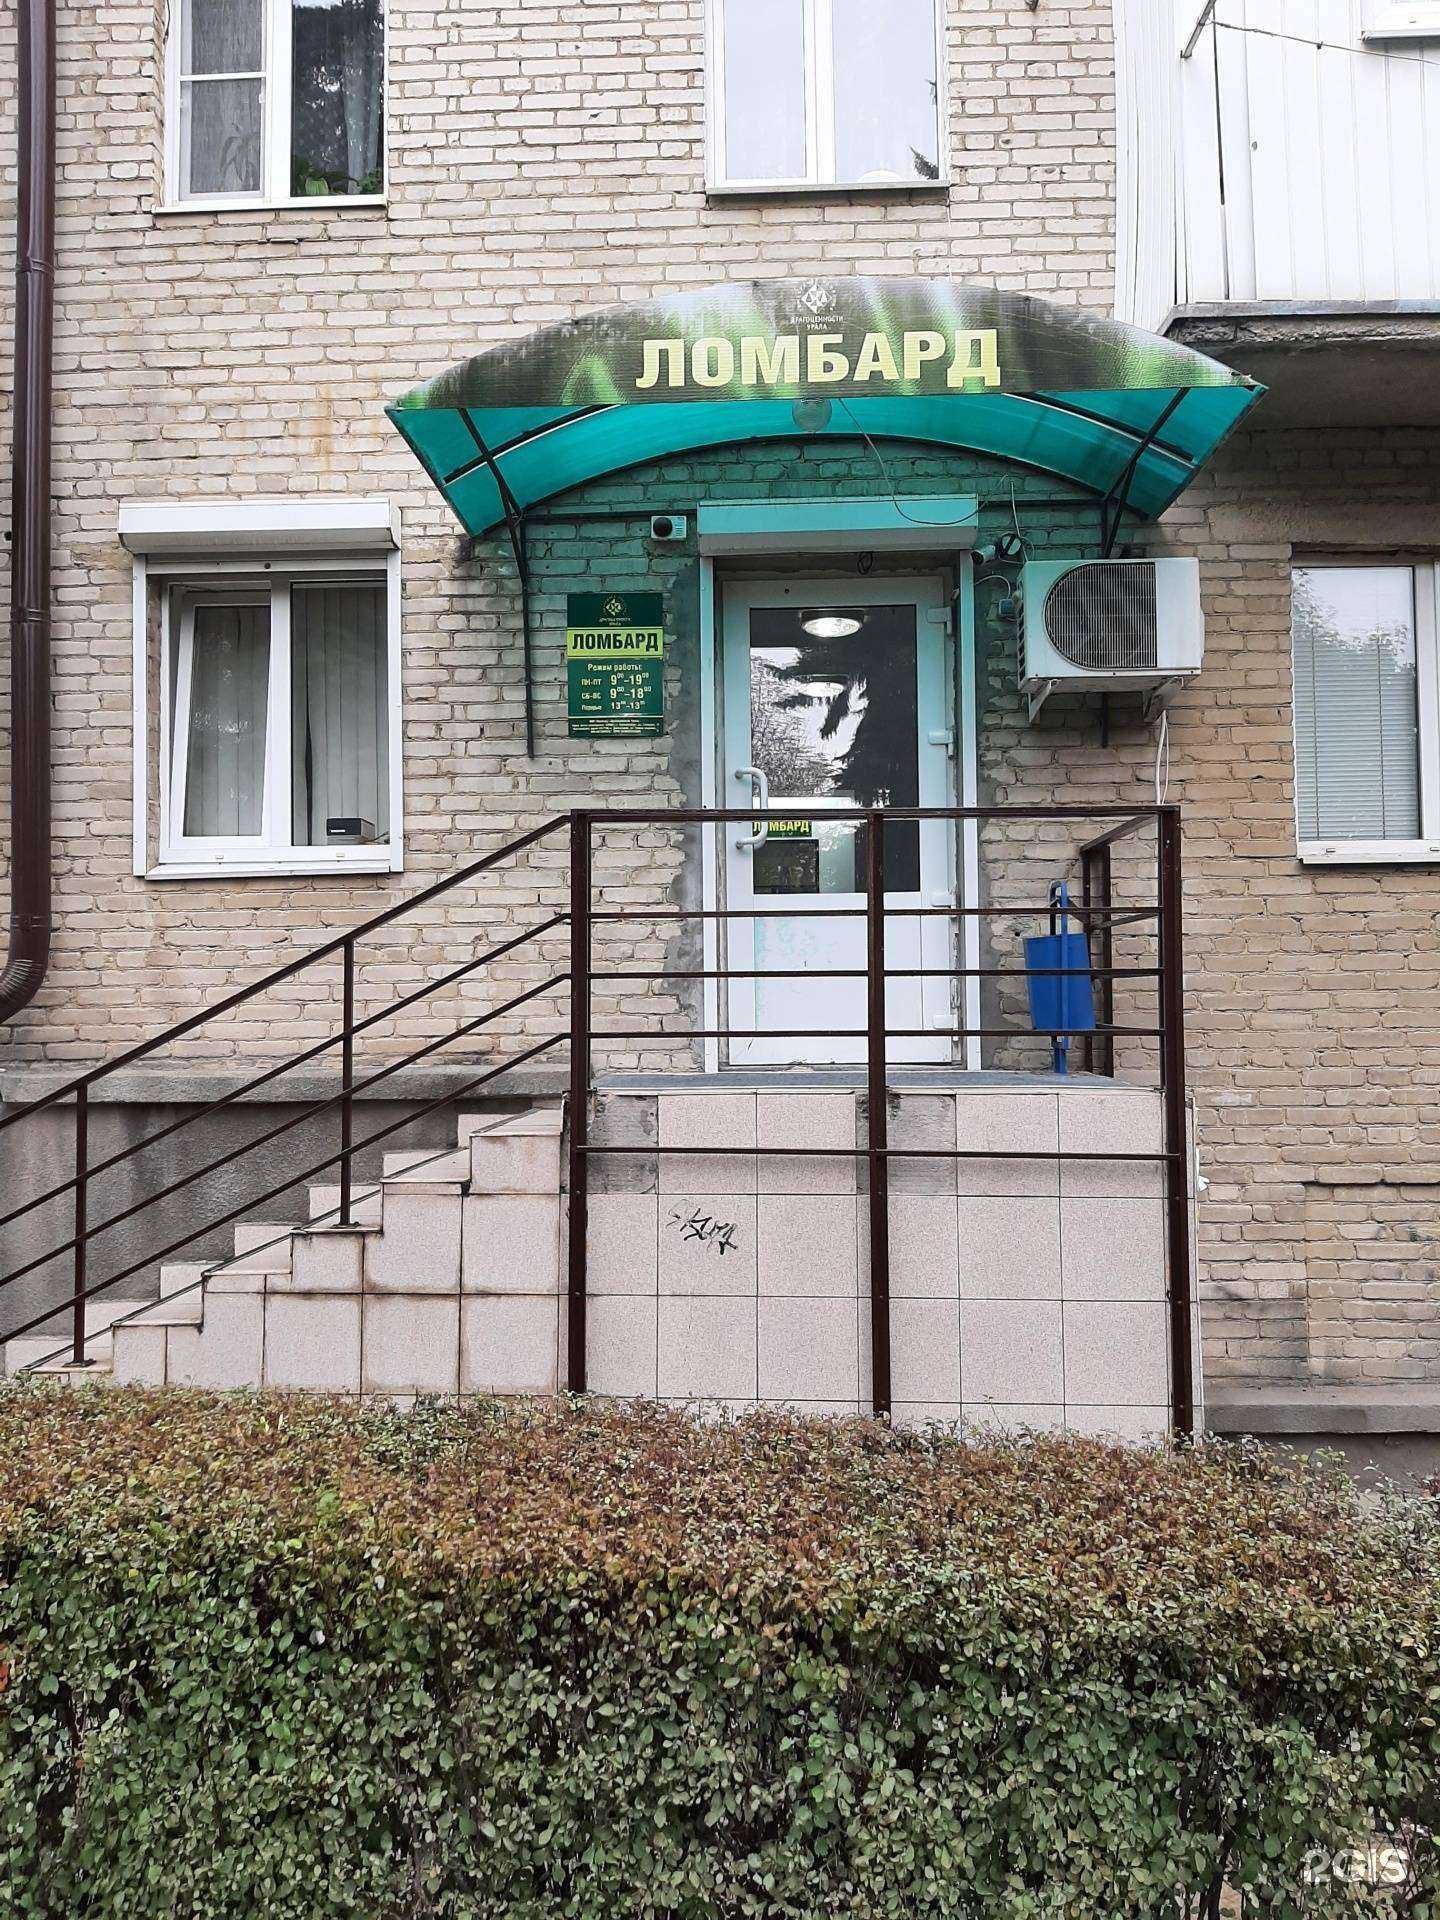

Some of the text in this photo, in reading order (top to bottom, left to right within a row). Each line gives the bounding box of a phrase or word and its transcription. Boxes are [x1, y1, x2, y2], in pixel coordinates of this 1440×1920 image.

[636, 329, 1001, 388] ЛОМБАРД
[572, 632, 659, 652] ЛОМБАРД
[753, 820, 810, 833] ЛМБАРД
